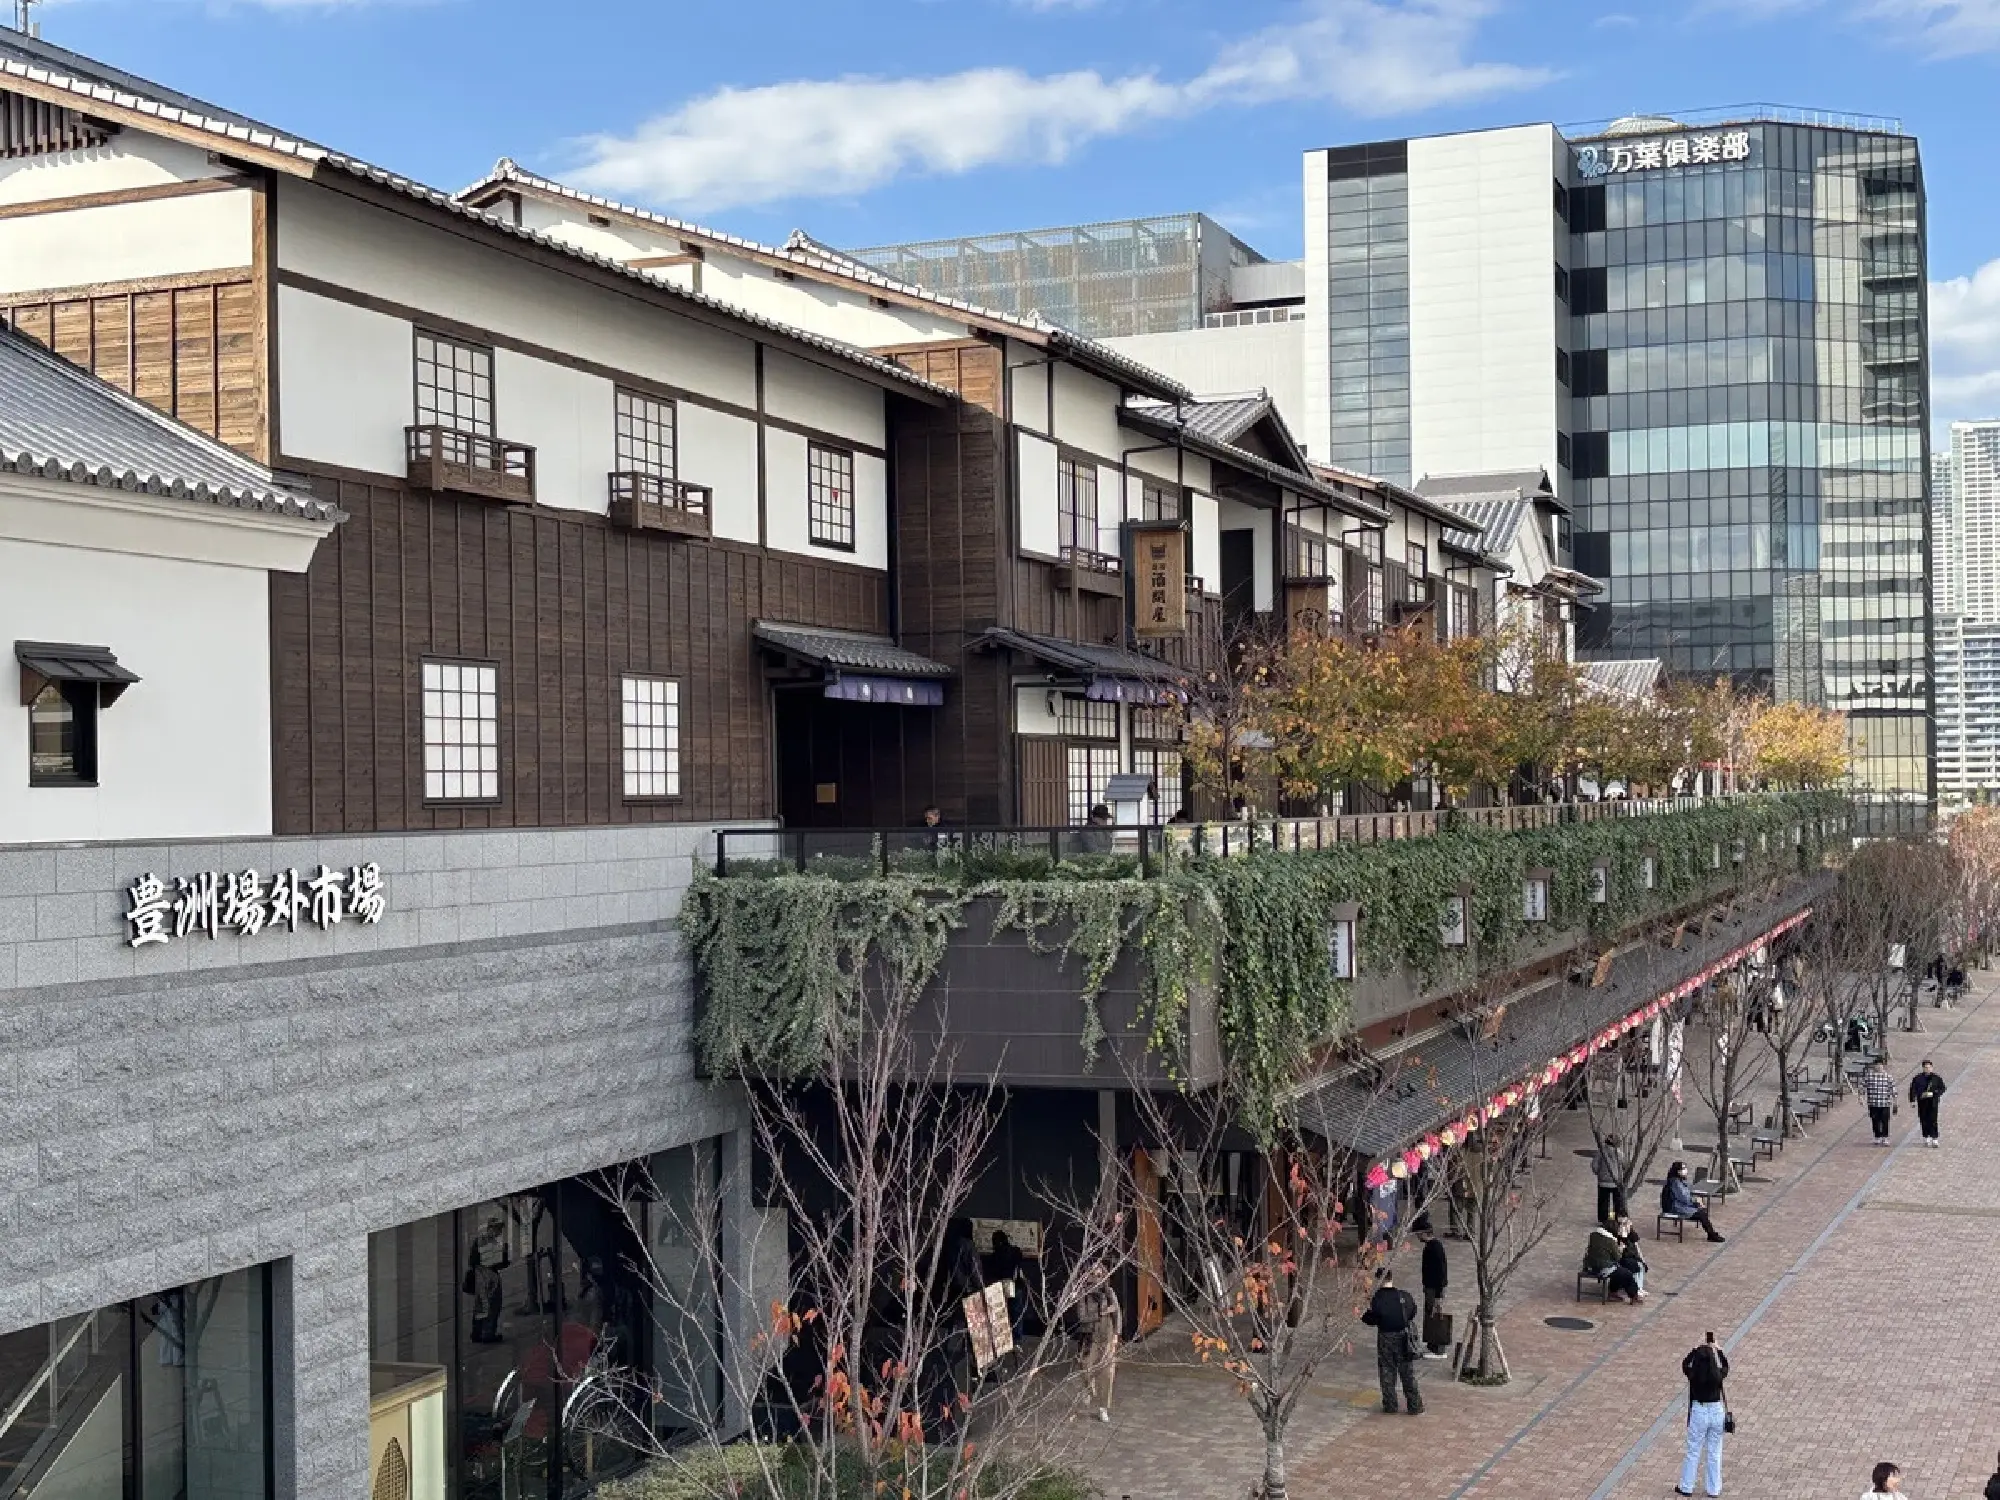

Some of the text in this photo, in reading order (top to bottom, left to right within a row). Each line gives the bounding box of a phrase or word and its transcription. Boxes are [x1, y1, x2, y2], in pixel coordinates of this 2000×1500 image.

[1606, 132, 1750, 173] 万葉倶楽部
[126, 862, 385, 947] 豊洲場外市場
